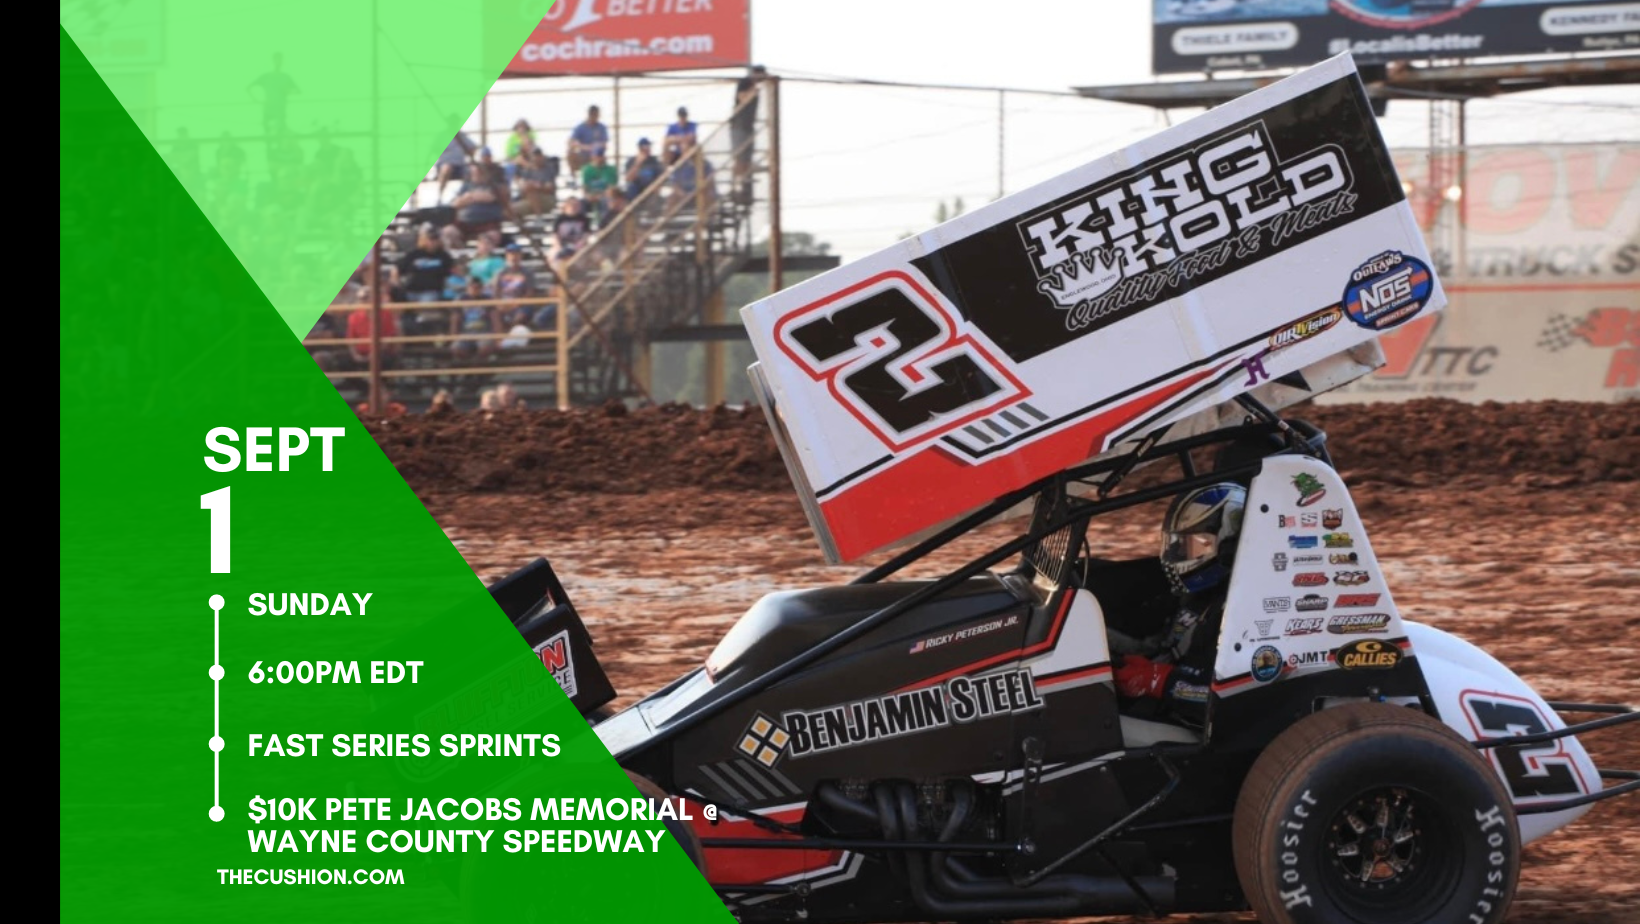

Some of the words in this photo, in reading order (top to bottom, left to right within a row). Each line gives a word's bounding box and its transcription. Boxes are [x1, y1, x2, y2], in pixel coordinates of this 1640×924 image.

[521, 34, 714, 62] cochran.com
[1027, 130, 1272, 269] KING
[1120, 150, 1346, 278] KOLD
[1066, 271, 1166, 331] Quality
[1168, 241, 1232, 285] Food
[1237, 227, 1260, 258] &
[1271, 191, 1358, 247] Meats
[1360, 266, 1413, 314] NOS
[780, 278, 1022, 446] 2
[925, 633, 955, 649] RICKY
[955, 620, 1003, 641] PETERSON
[1004, 615, 1019, 627] JR.
[1286, 618, 1324, 632] KEARS
[1330, 614, 1387, 627] GRESSMAN
[1344, 652, 1398, 668] CALLIES
[783, 684, 949, 758] BENJAMIN
[948, 667, 1045, 722] STEEL
[1463, 694, 1588, 804] 2
[1279, 789, 1318, 911] Hoosier
[1468, 805, 1505, 924] Hoosier
